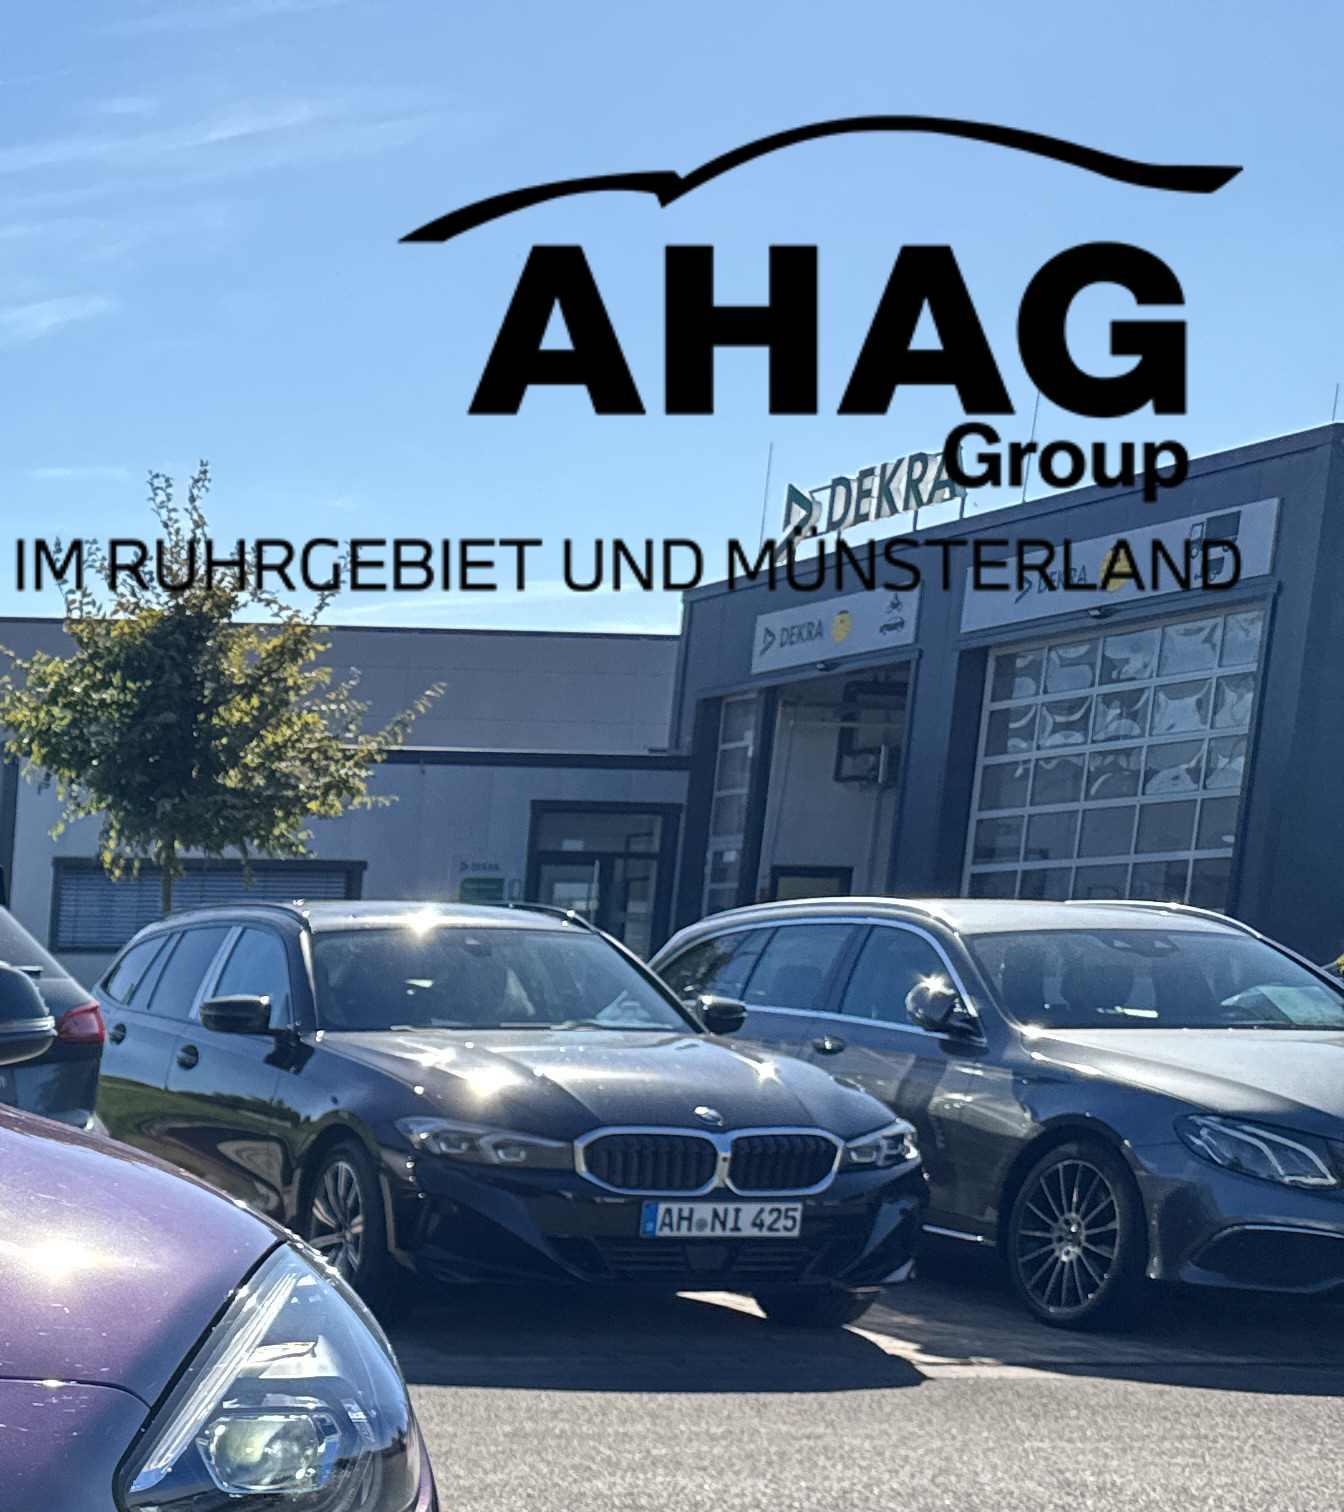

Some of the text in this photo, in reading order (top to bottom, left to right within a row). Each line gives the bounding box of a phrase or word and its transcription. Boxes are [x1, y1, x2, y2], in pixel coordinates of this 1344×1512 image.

[779, 619, 824, 649] DEKRA
[658, 1206, 799, 1233] AH NI 425
